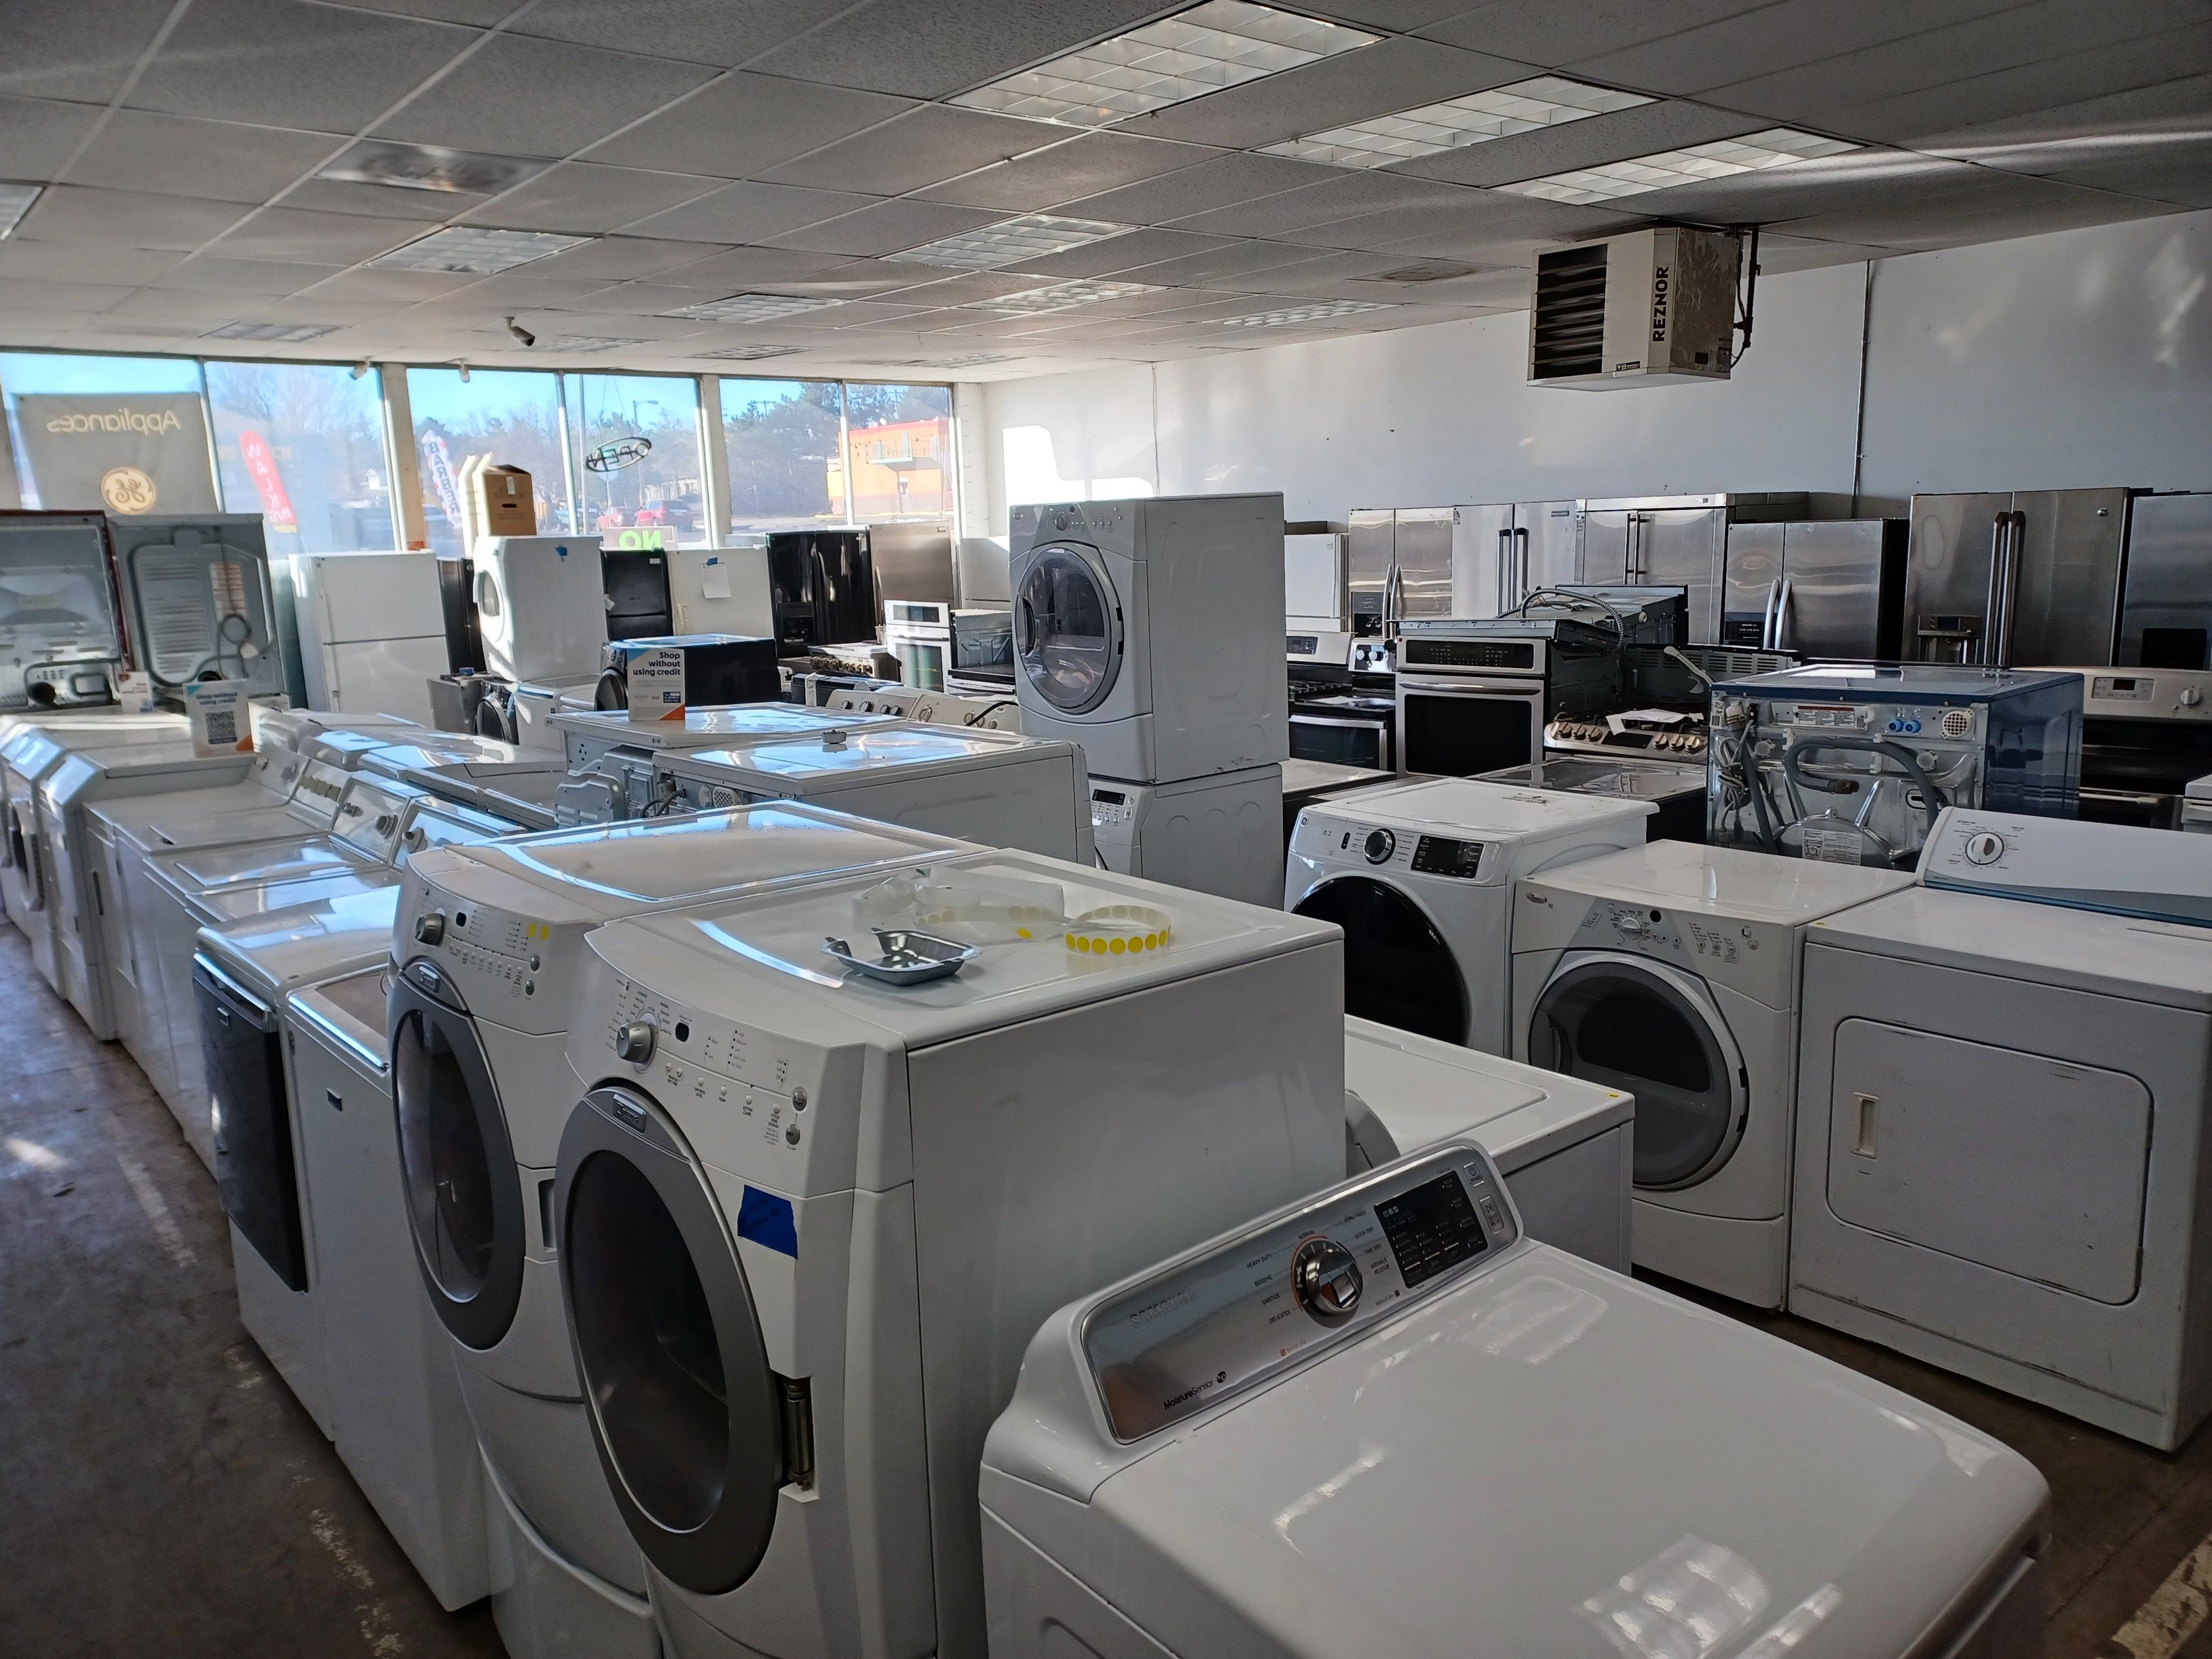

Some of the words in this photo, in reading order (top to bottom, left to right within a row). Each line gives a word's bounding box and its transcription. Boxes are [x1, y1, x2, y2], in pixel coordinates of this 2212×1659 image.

[1652, 265, 1669, 342] REZNOR
[659, 651, 680, 660] Shop
[633, 668, 655, 676] using
[1298, 1229, 1316, 1239] NORMAL
[1354, 1230, 1365, 1240] QUICK
[1246, 1259, 1261, 1269] HEAVY
[1261, 1253, 1272, 1263] DUTY
[1370, 1257, 1387, 1269] WRINKLE
[1374, 1264, 1390, 1275] RELEASE
[1254, 1275, 1273, 1287] BEDDING
[1261, 1292, 1281, 1306] SANITIZE
[1130, 1288, 1196, 1326] SAMSUNG
[1269, 1309, 1291, 1324] DELICATES
